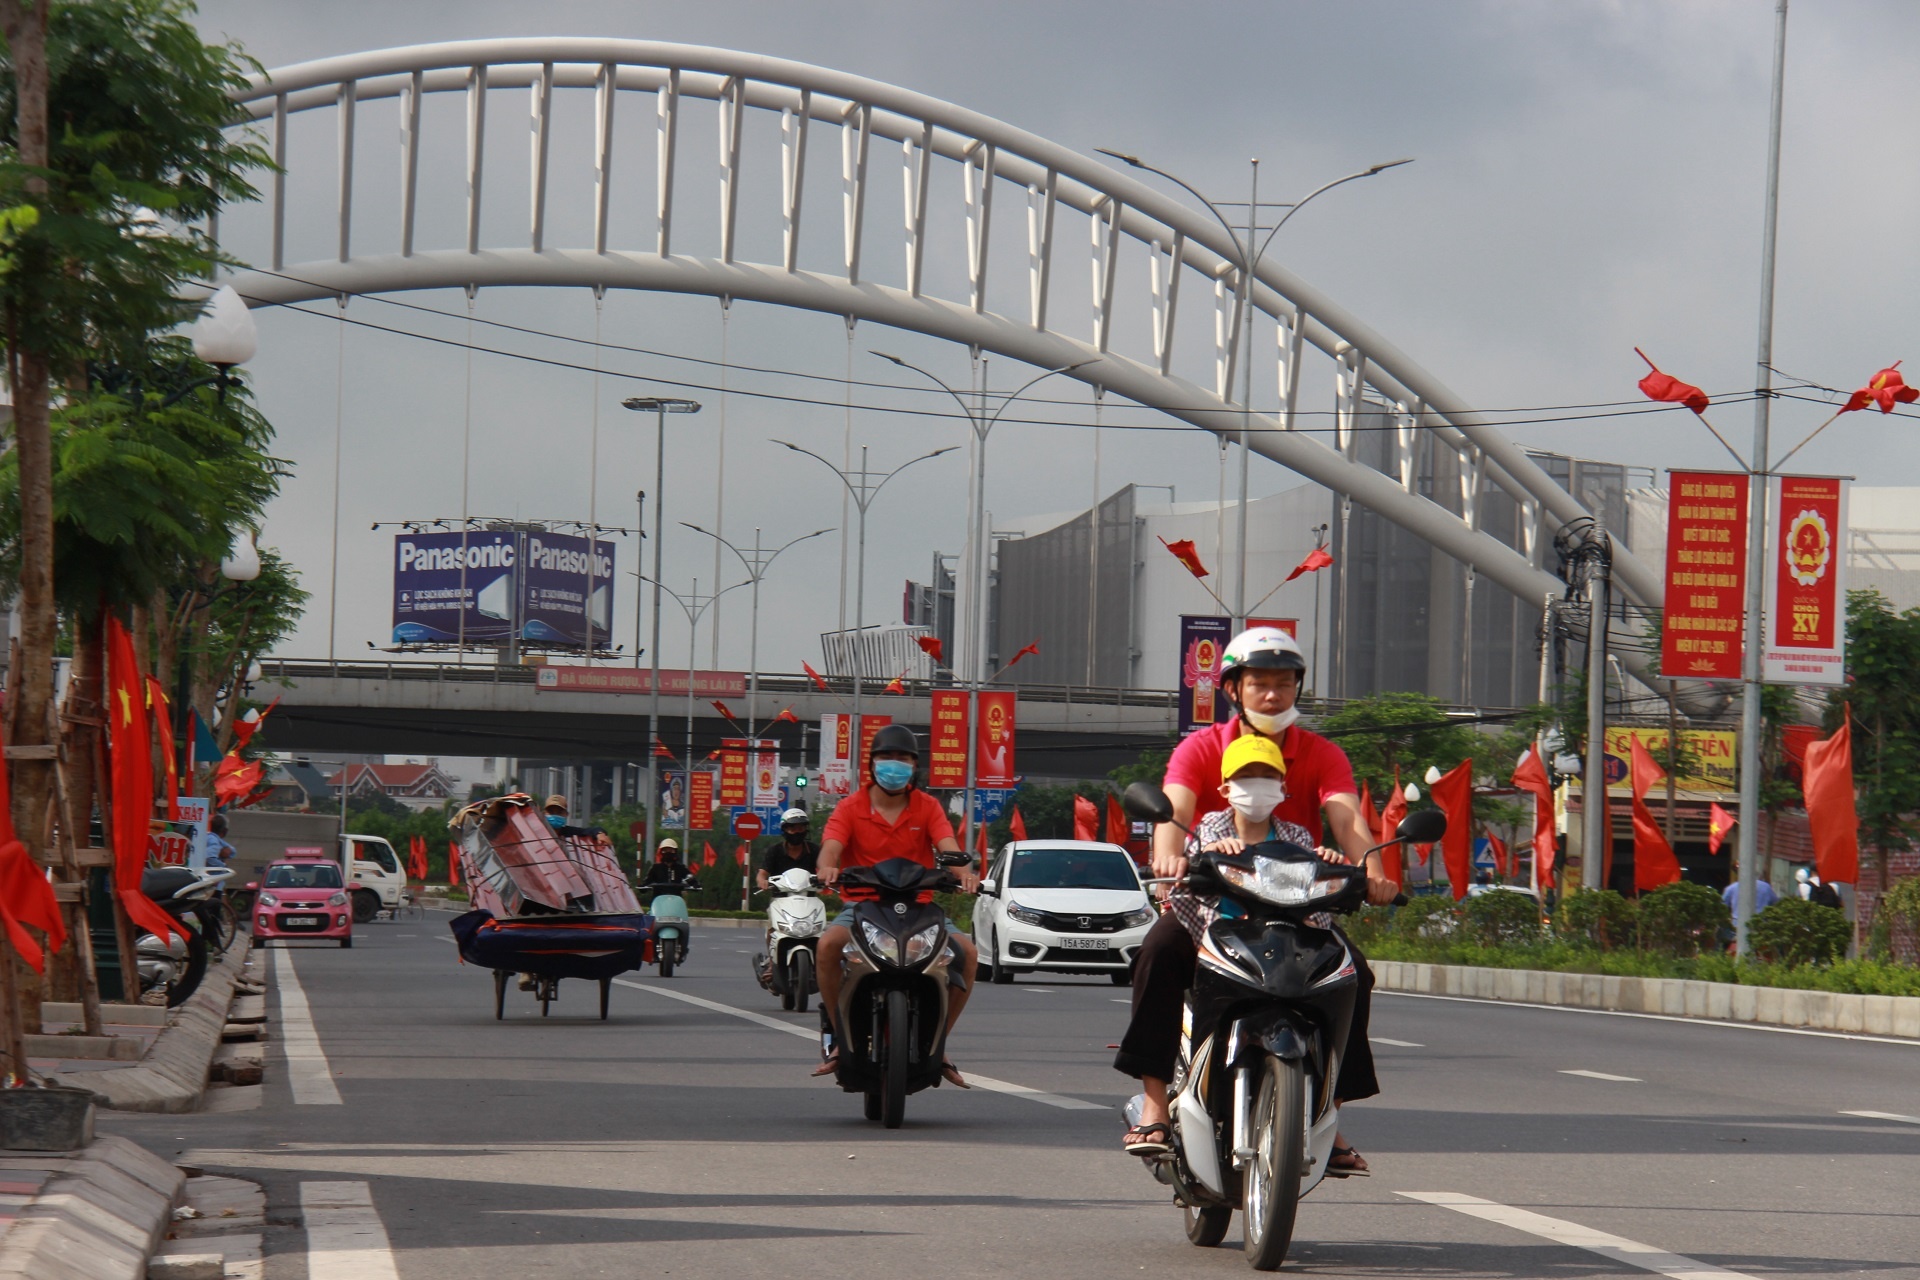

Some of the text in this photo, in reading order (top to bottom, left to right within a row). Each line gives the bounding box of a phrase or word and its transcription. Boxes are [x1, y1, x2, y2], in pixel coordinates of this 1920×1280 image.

[400, 537, 514, 572] Panasonic
[529, 538, 611, 578] Panasonic
[1792, 612, 1819, 633] XV
[579, 671, 607, 686] UỐNG
[610, 674, 641, 688] RƯỢU,
[644, 677, 662, 687] BA
[710, 676, 726, 690] LÁI
[730, 680, 742, 691] XE
[1064, 939, 1106, 949] 15A-587.65
